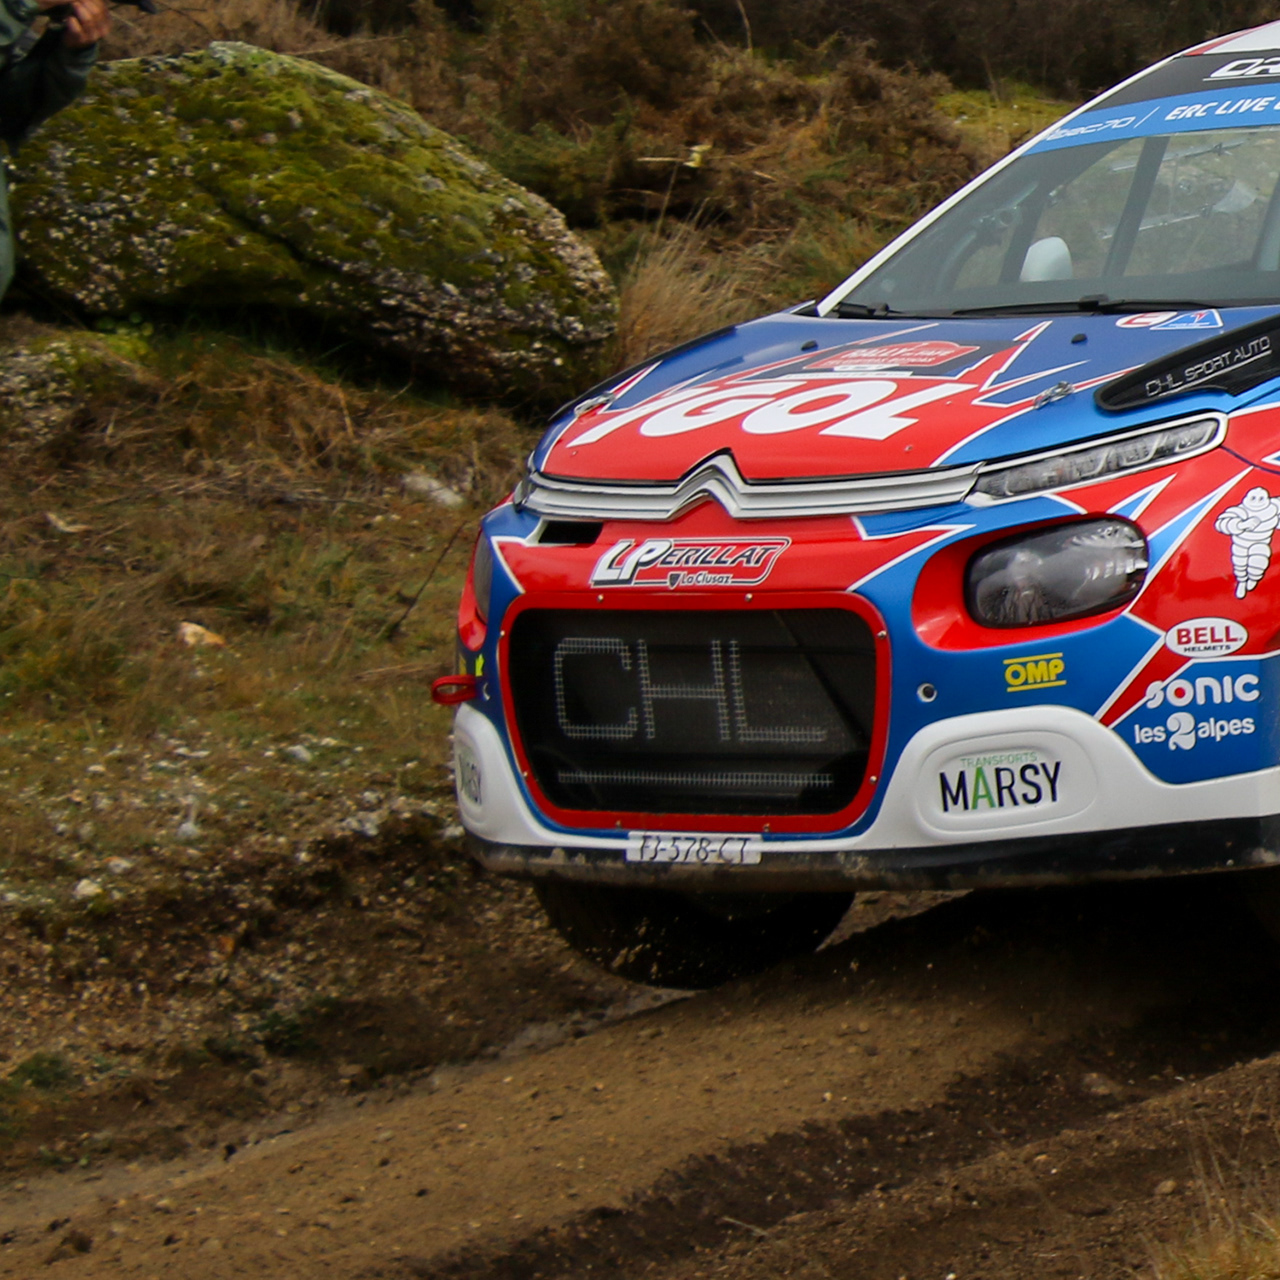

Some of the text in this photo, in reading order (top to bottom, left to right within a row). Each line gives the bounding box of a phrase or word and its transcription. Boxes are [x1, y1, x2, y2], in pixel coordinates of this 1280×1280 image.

[1165, 101, 1218, 121] ERC
[1214, 96, 1277, 116] LIVE
[1144, 335, 1271, 397] CHL SPORT AUTO
[566, 380, 980, 448] IGOL
[1176, 625, 1239, 646] BELL
[1183, 644, 1232, 653] HELMETS
[553, 637, 828, 742] CHL
[1004, 658, 1065, 687] OMP
[1133, 711, 1256, 751] les 2 alpes
[960, 751, 1039, 768] TRANSPORTS
[939, 760, 1062, 813] MARSY
